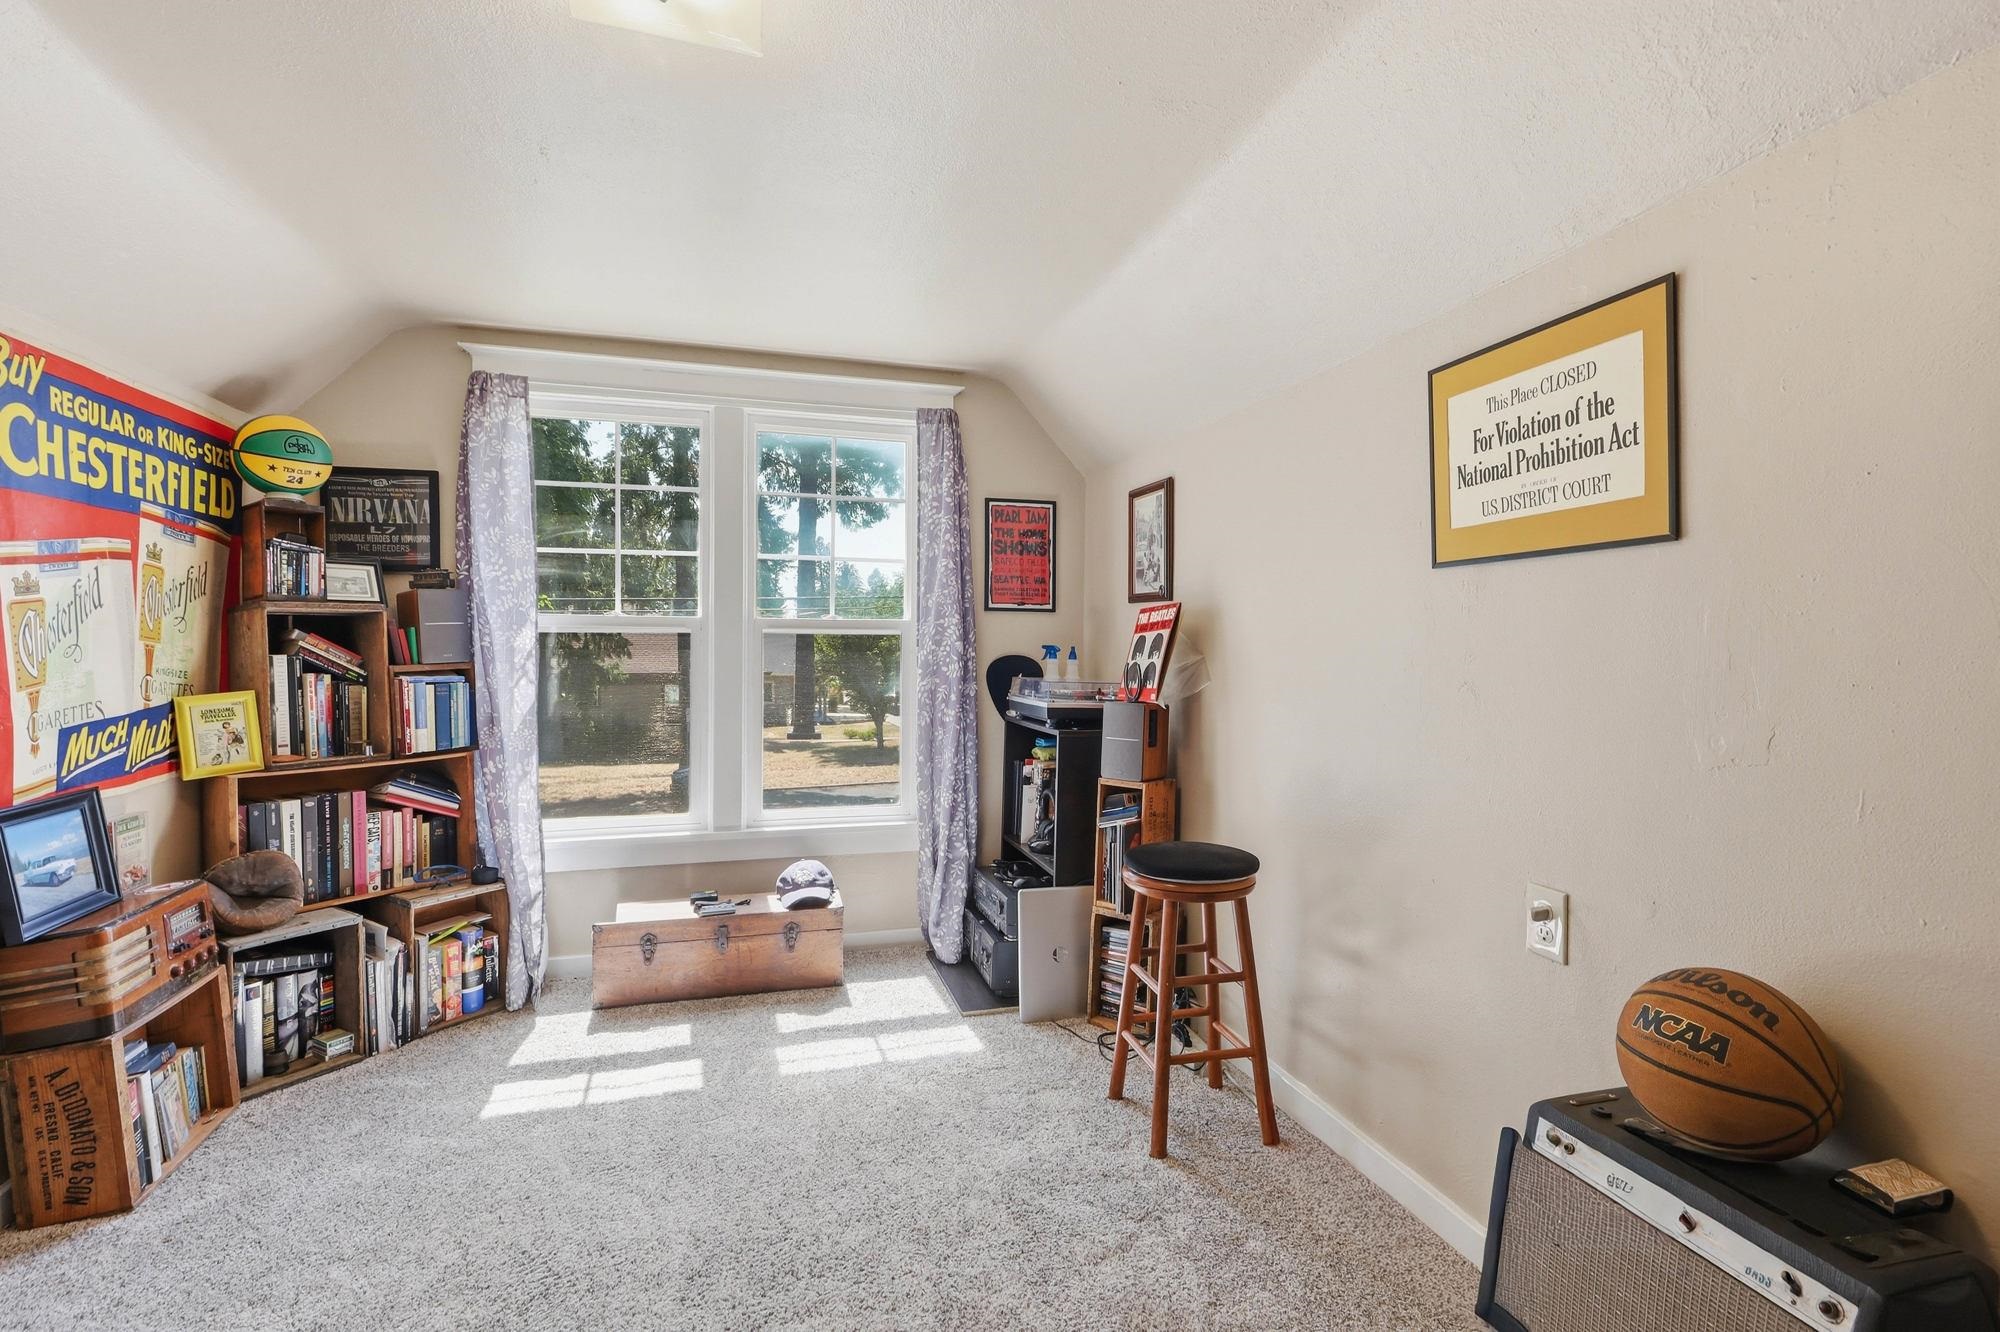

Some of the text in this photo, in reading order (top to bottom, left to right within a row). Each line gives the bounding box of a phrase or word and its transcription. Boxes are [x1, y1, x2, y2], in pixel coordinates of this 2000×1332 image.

[1486, 360, 1597, 413] This Place CLOSED
[49, 384, 136, 440] REGULAR
[137, 425, 154, 446] OR
[157, 425, 229, 471] KING-SIZE
[1473, 391, 1615, 454] For Violation of the
[0, 402, 235, 519] CHESTERFIELD
[1457, 421, 1640, 490] National Prohibition Act
[1501, 485, 1558, 514] DISTRICT
[1562, 473, 1611, 500] COURT
[330, 497, 430, 523] NIRVANA
[994, 509, 1048, 525] PEARL JAM
[371, 526, 396, 534] L7
[994, 528, 1047, 540] THE HOME
[357, 543, 410, 553] THE BREEDERS
[993, 540, 1048, 557] SHOWS
[18, 566, 104, 680] Chesterfield
[485, 955, 495, 982] Juliette
[1645, 966, 1779, 1032] Wilson
[1632, 1002, 1732, 1067] NCAA
[44, 1067, 69, 1087] A.
[50, 1149, 64, 1181] CALIF.
[70, 1161, 96, 1171] &
[62, 1176, 93, 1205] SON
